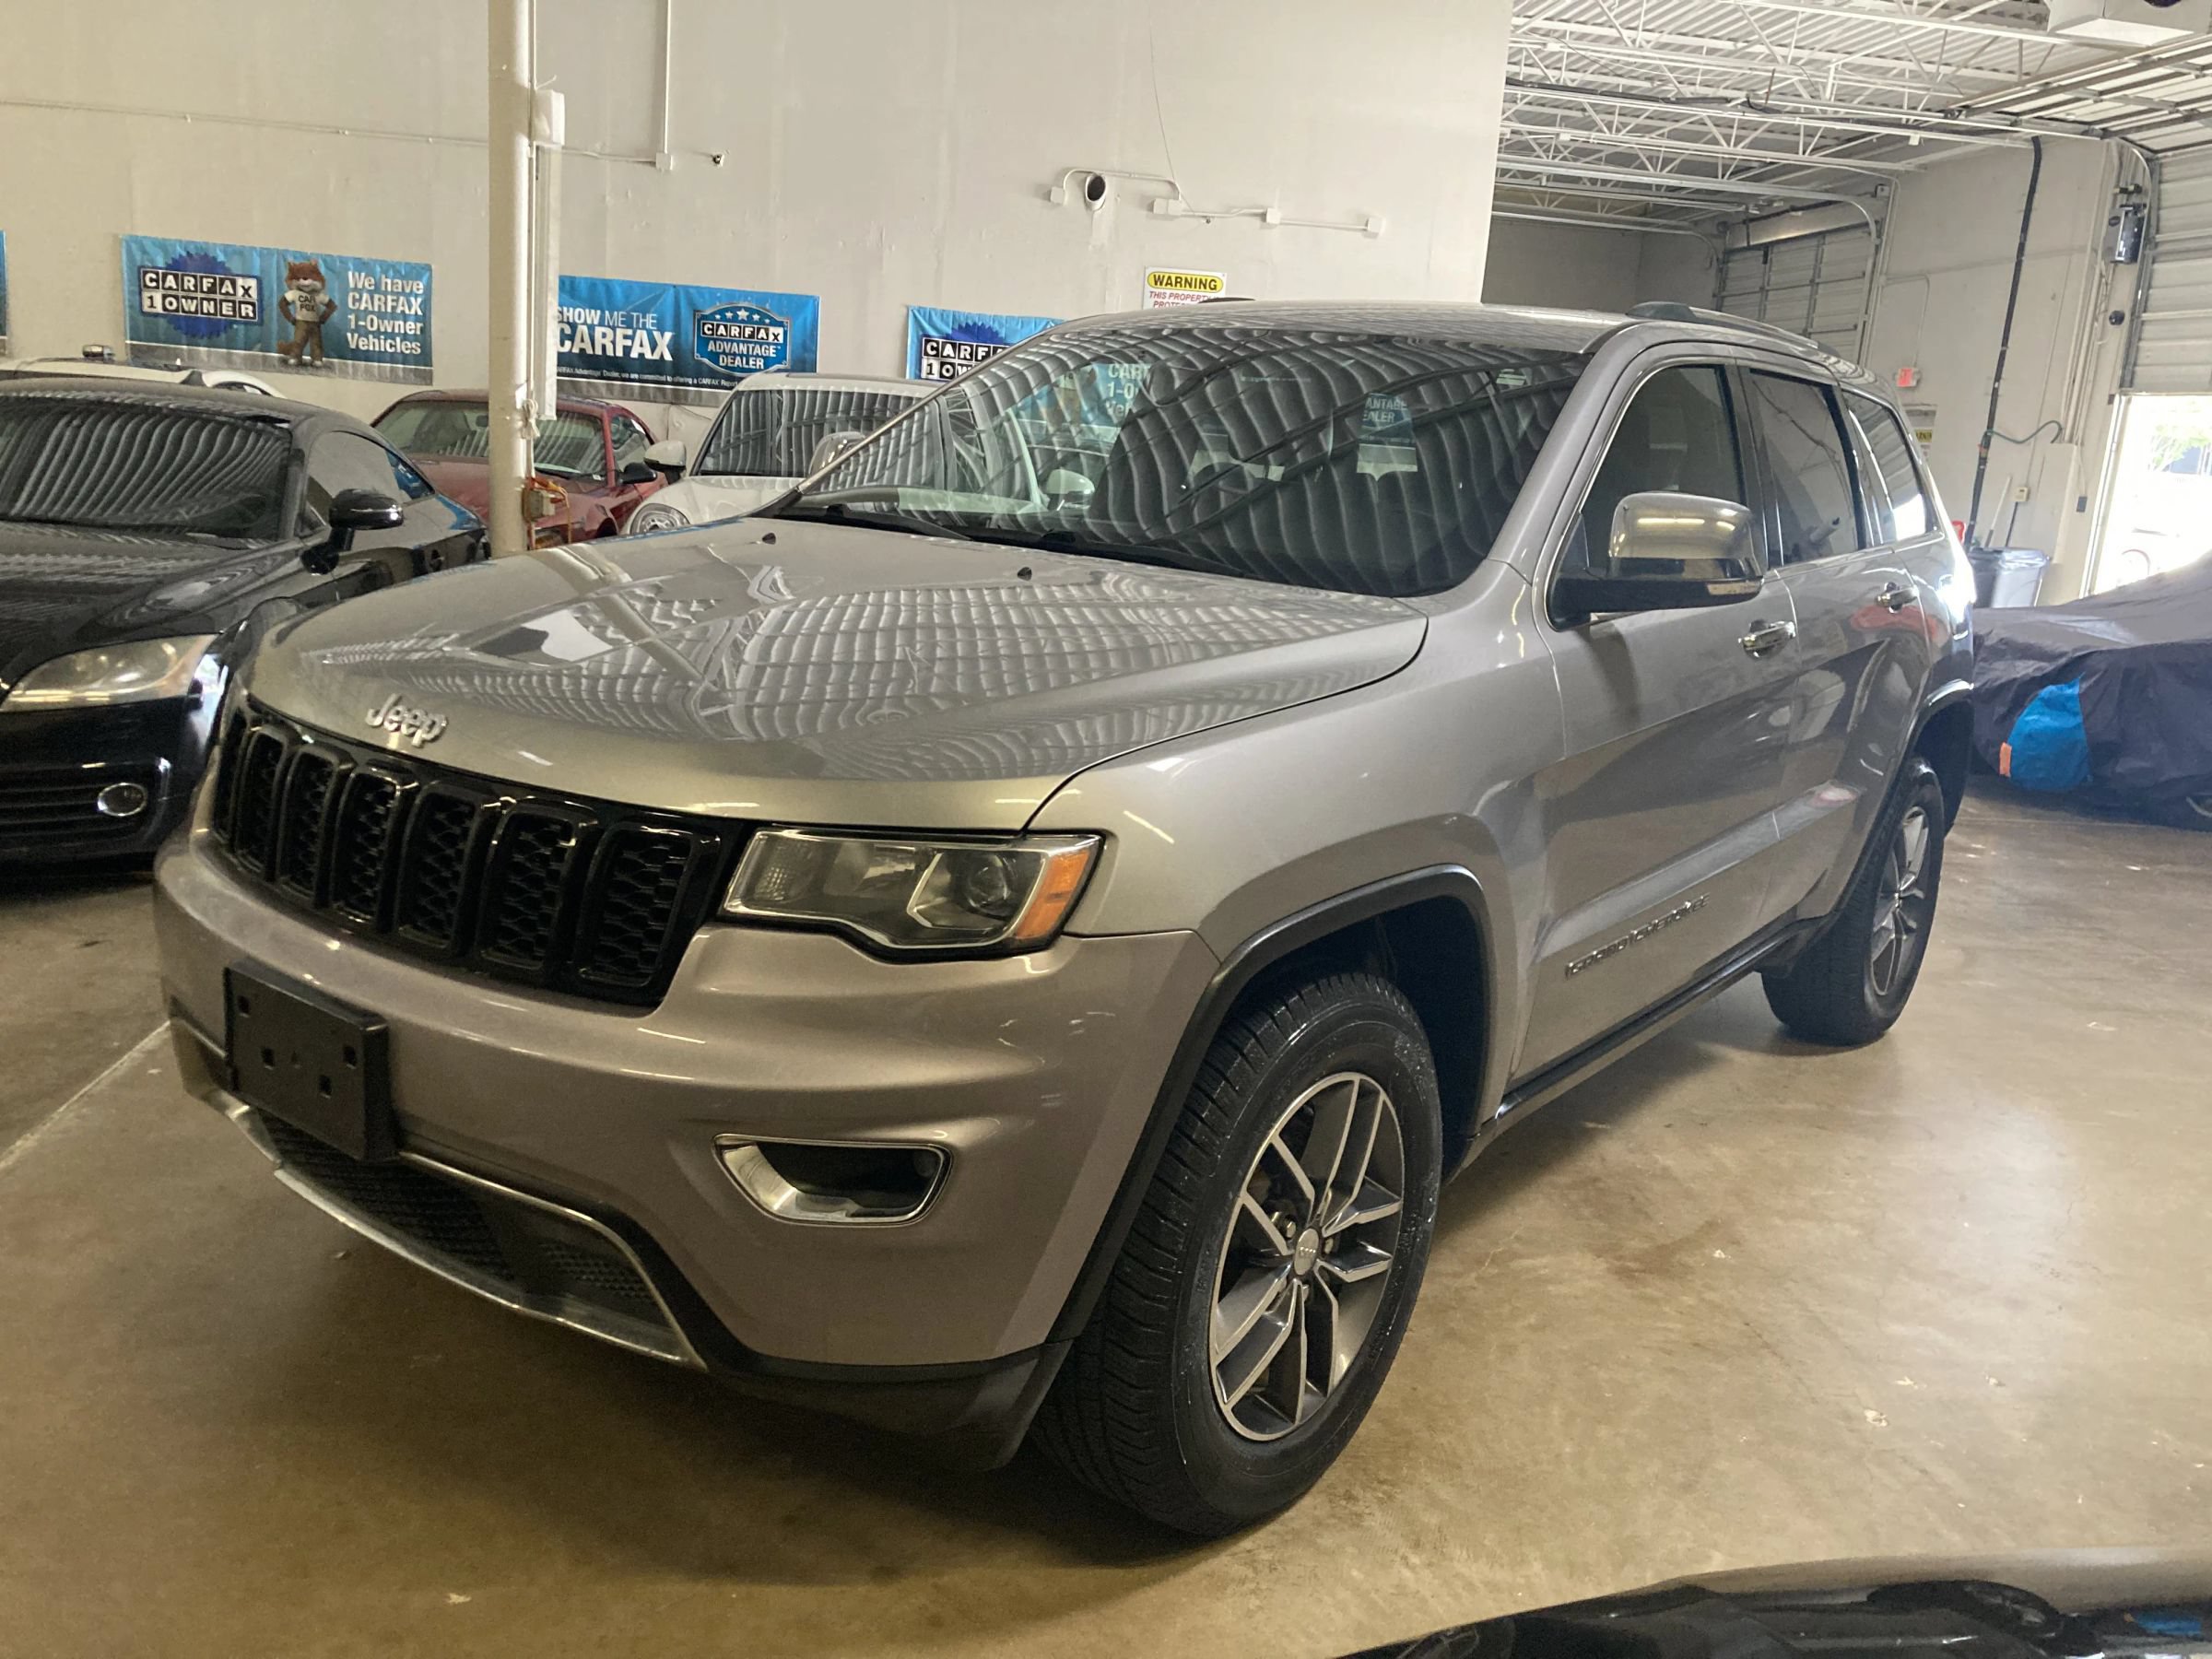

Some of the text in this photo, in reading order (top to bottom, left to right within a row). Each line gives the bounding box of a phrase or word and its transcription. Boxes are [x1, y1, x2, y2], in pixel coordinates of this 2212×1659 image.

[145, 273, 252, 298] CARFAX
[347, 271, 424, 295] We have
[1153, 274, 1218, 291] WARNING
[347, 291, 423, 315] CARFAX
[1149, 291, 1168, 300] THIS
[347, 313, 423, 335] 1-Owner
[605, 311, 627, 327] ME
[630, 312, 657, 330] THE
[347, 332, 421, 354] Vehicles
[558, 323, 673, 361] CARFAX
[703, 324, 780, 342] CARFAX
[926, 341, 1004, 360] CARF
[719, 355, 765, 370] DEALER
[365, 693, 448, 747] Jeep
